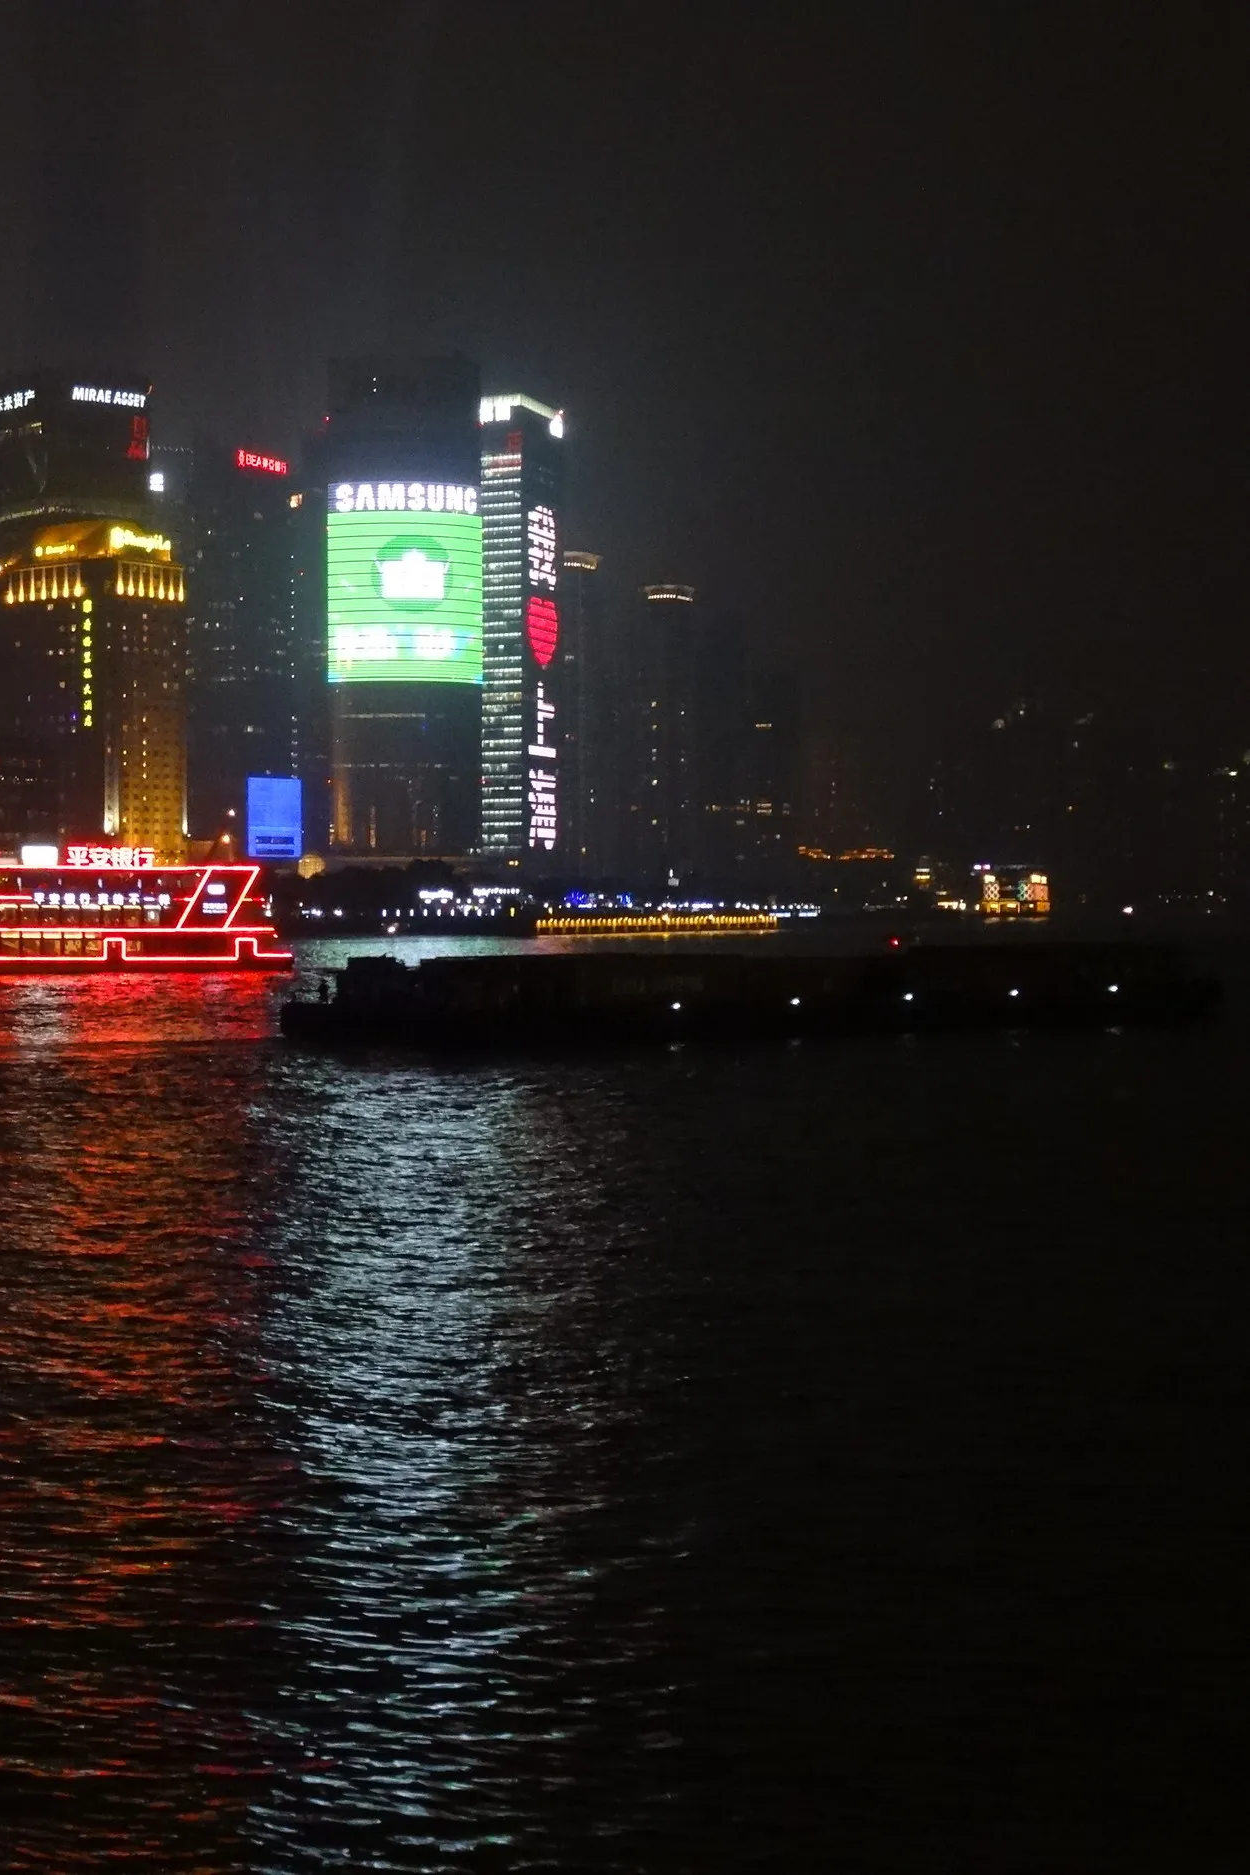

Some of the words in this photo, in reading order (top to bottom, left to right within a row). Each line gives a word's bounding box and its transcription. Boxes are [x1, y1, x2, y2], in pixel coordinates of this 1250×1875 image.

[72, 386, 111, 404] MIRAE
[113, 391, 146, 408] ASSET
[335, 483, 478, 514] SAMSUNG
[66, 846, 155, 867] 平安银行
